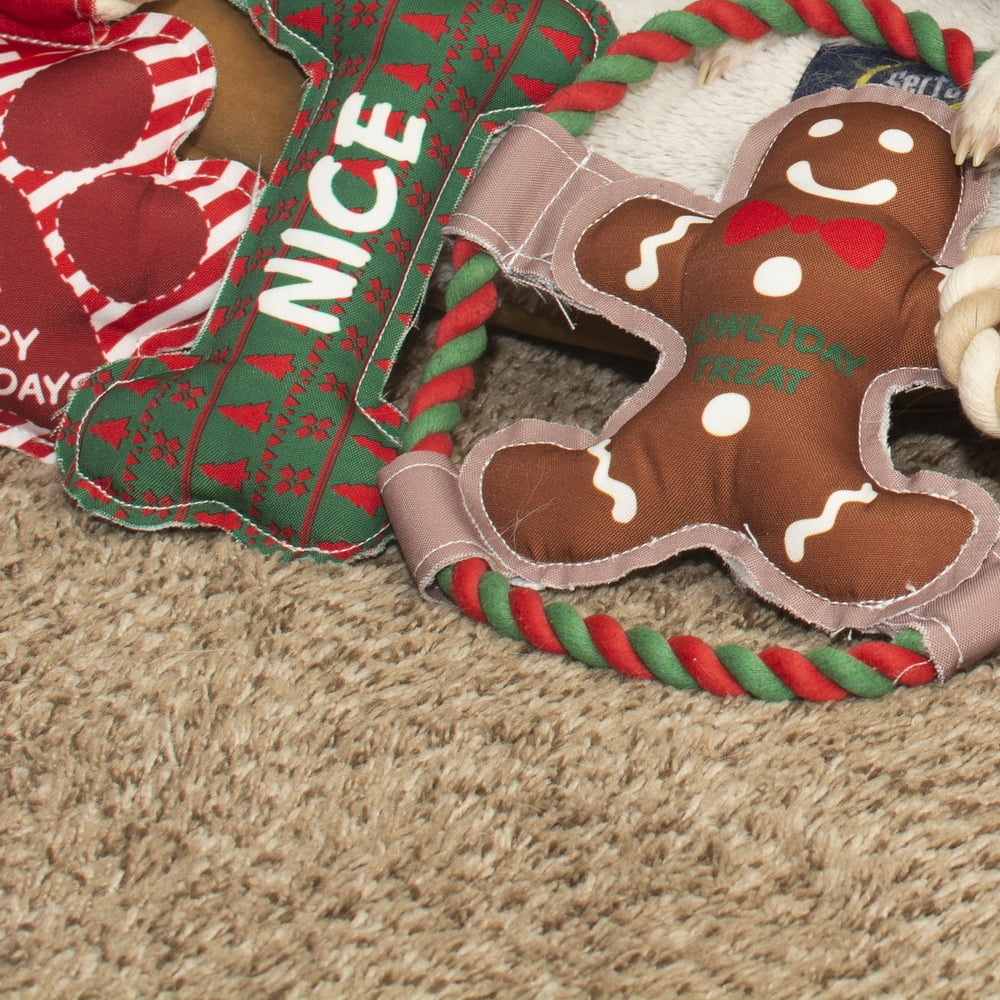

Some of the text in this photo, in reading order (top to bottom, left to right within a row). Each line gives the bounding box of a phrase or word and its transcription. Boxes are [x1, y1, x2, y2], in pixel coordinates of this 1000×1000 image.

[259, 92, 427, 334] NICE
[689, 312, 867, 378] OWL-IDAY
[693, 354, 812, 395] TREAT
